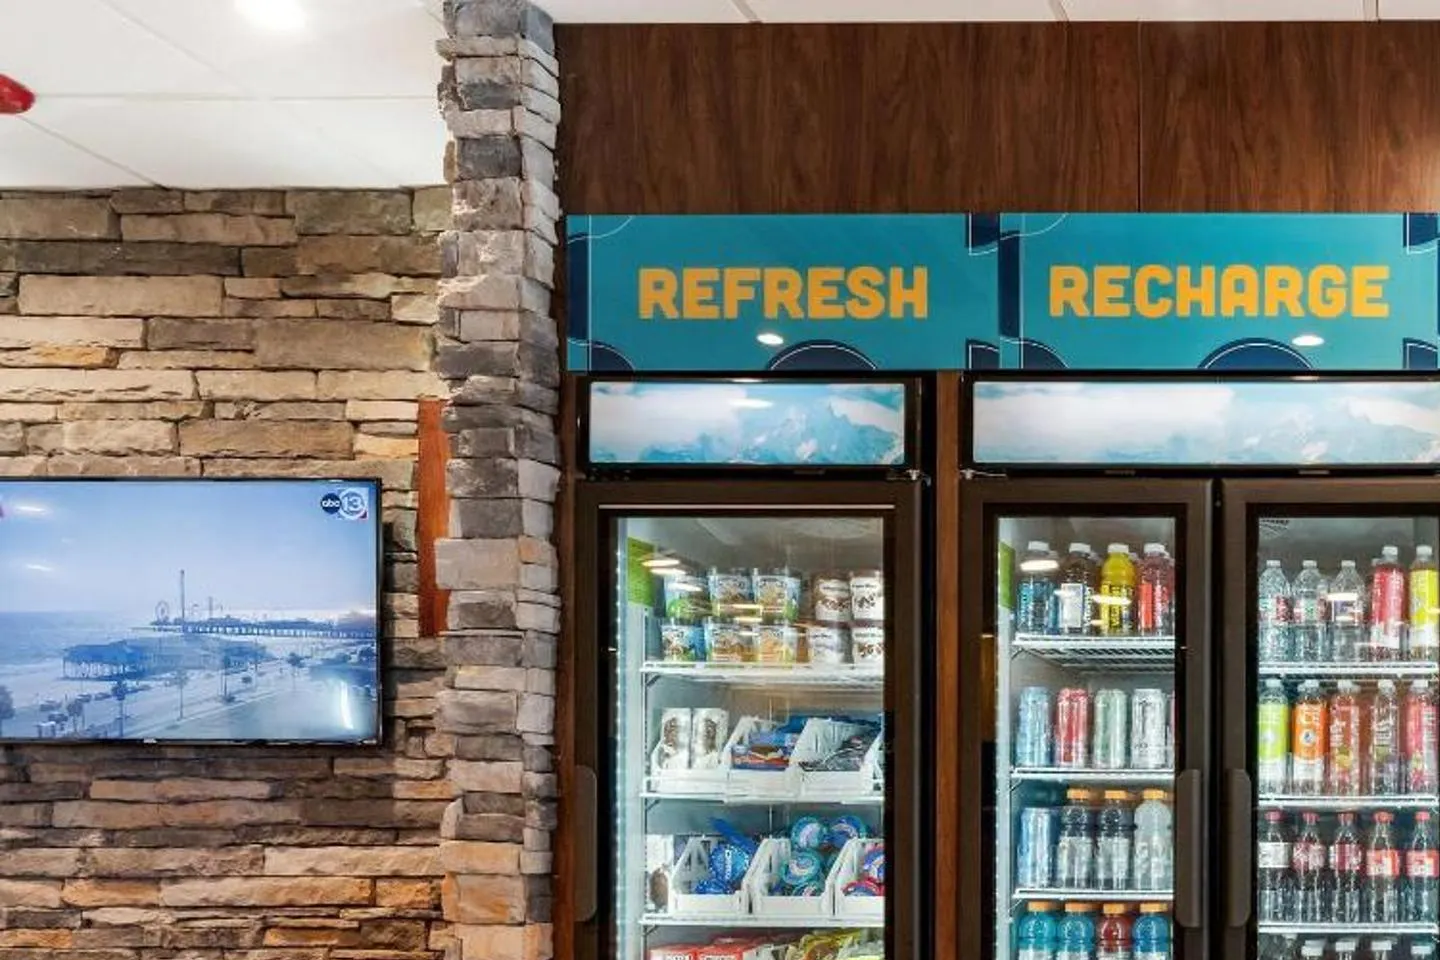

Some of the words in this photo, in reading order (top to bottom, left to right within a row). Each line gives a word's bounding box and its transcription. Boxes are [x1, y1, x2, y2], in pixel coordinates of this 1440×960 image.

[638, 266, 929, 320] REFRESH
[1049, 264, 1391, 318] RECHARGE
[321, 498, 340, 507] abc
